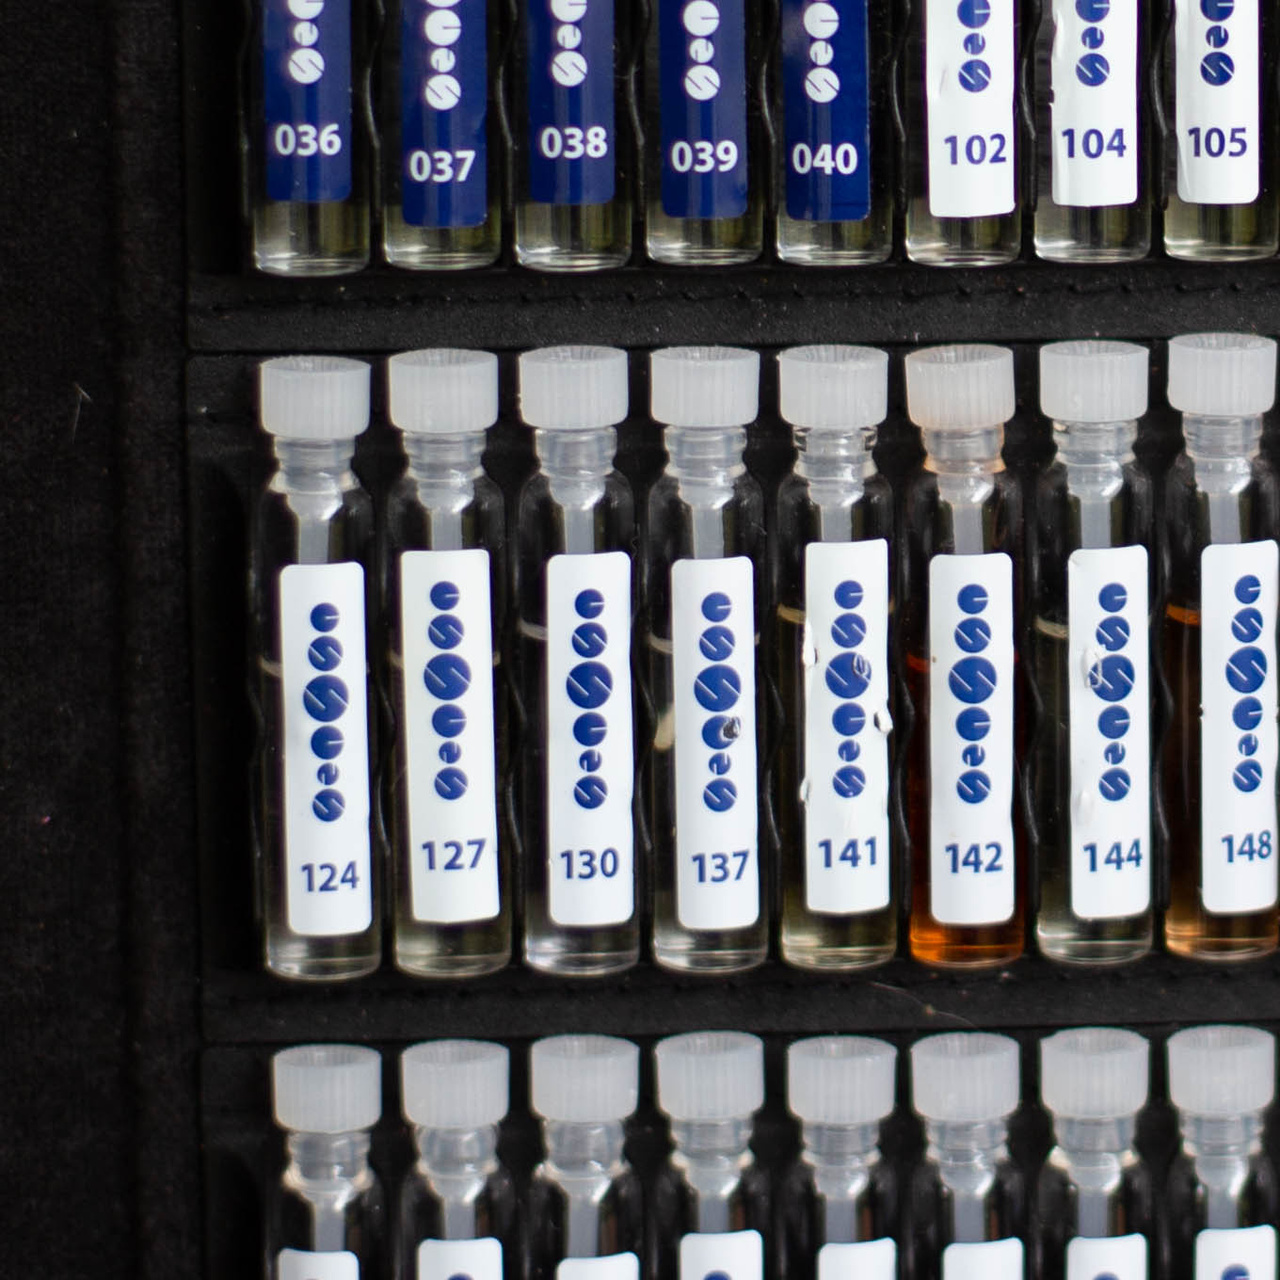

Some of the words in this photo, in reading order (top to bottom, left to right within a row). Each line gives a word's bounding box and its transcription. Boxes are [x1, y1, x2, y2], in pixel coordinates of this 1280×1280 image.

[275, 123, 342, 157] 036
[541, 125, 608, 159] 038
[672, 139, 738, 173] 039
[944, 133, 1007, 165] 102
[1061, 128, 1127, 159] 104
[1187, 126, 1248, 158] 105
[410, 149, 476, 183] 037
[792, 142, 858, 175] 040
[421, 839, 486, 871] 127
[818, 837, 876, 869] 141
[945, 843, 1003, 874] 142
[1083, 839, 1143, 873] 144
[1221, 830, 1272, 864] 148
[301, 861, 358, 893] 124
[560, 848, 619, 880] 130
[692, 850, 749, 883] 137
